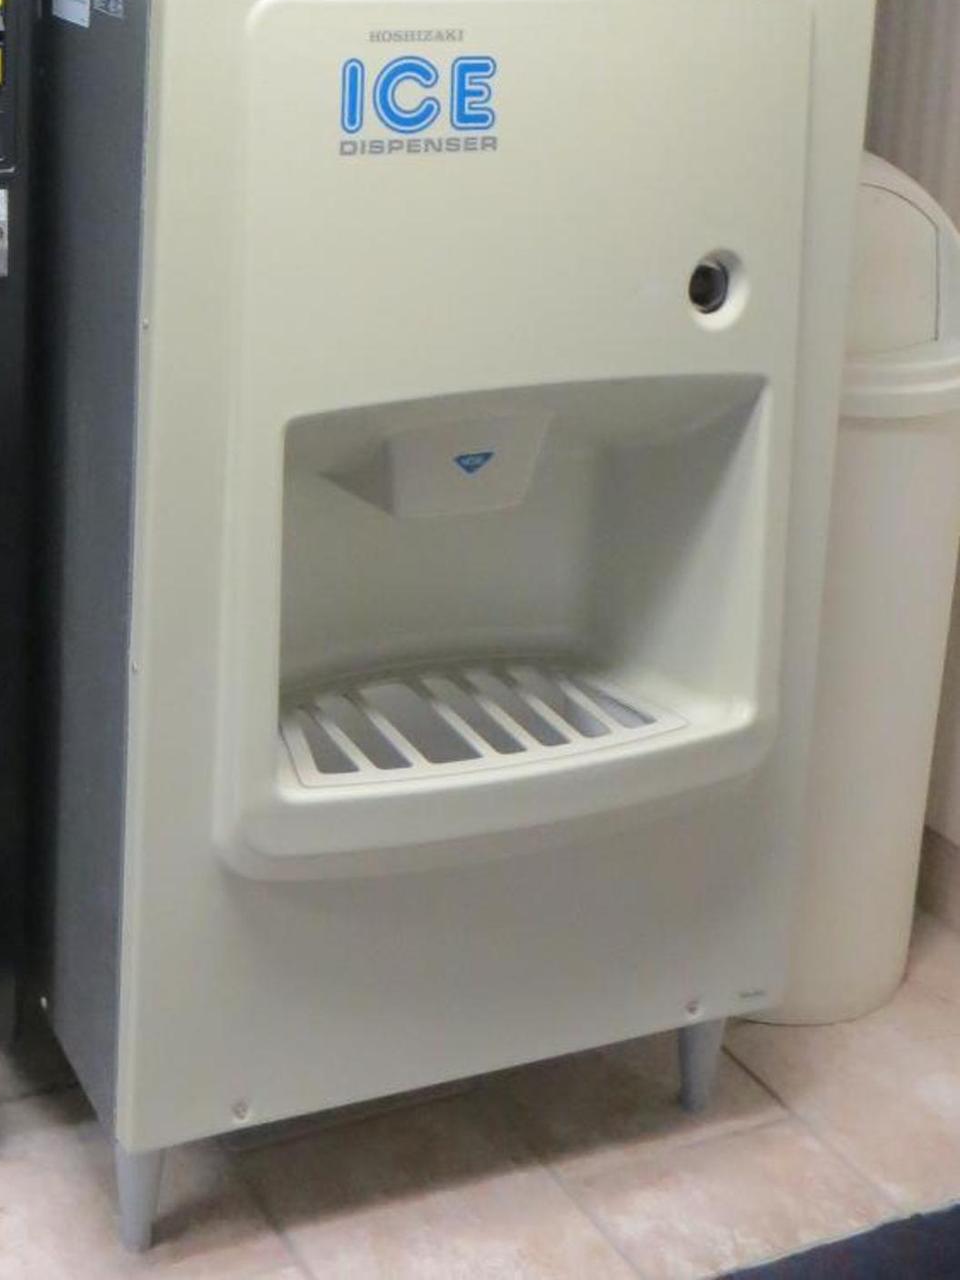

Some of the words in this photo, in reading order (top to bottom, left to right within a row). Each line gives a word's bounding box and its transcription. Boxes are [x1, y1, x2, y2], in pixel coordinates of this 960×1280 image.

[369, 29, 464, 43] HOSHIZAKI
[341, 56, 497, 134] ICE
[340, 135, 498, 156] DISPENSER
